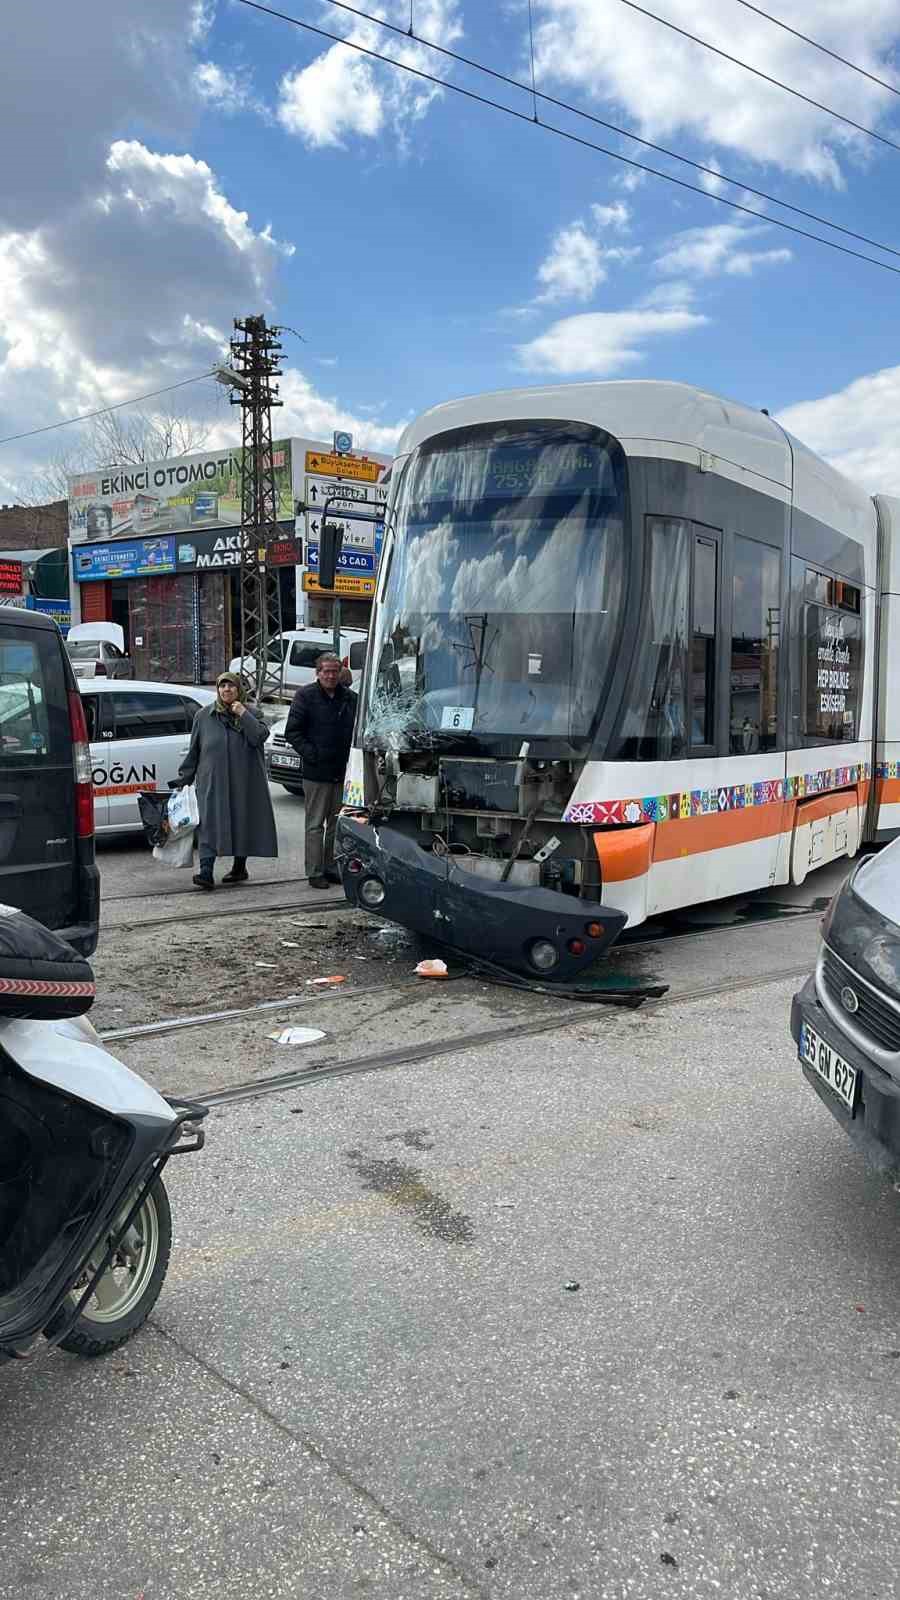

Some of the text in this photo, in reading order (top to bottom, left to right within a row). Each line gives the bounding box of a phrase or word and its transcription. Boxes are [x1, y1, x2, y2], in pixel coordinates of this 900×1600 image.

[101, 467, 149, 496] EKİNCİ
[349, 557, 369, 567] CAD.
[817, 669, 829, 688] HEP
[453, 714, 460, 727] 6
[92, 762, 156, 785] OĞAN
[805, 1027, 854, 1101] 55 GN 627
